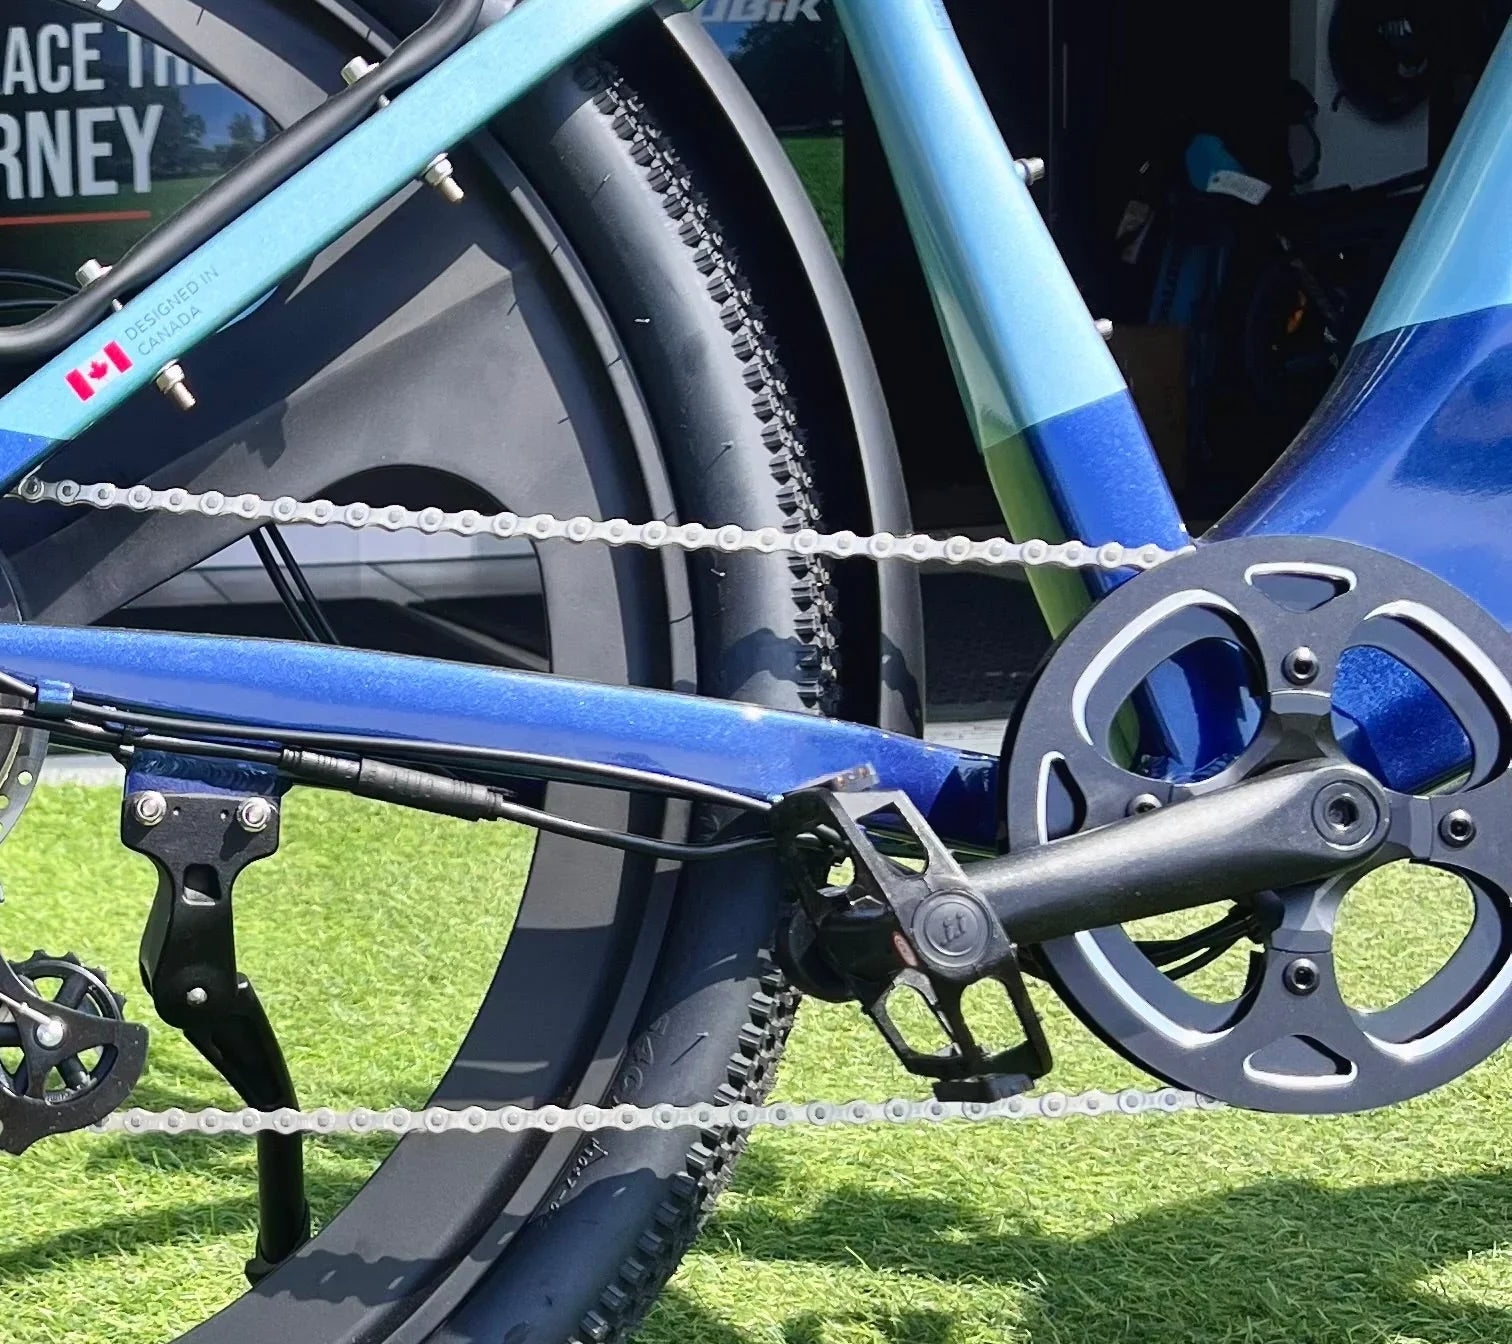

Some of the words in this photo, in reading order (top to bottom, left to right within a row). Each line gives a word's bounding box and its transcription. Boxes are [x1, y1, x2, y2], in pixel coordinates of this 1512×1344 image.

[116, 24, 220, 88] TH
[125, 280, 199, 341] DESIGNED
[199, 264, 219, 284] IN
[137, 305, 202, 356] CANADA
